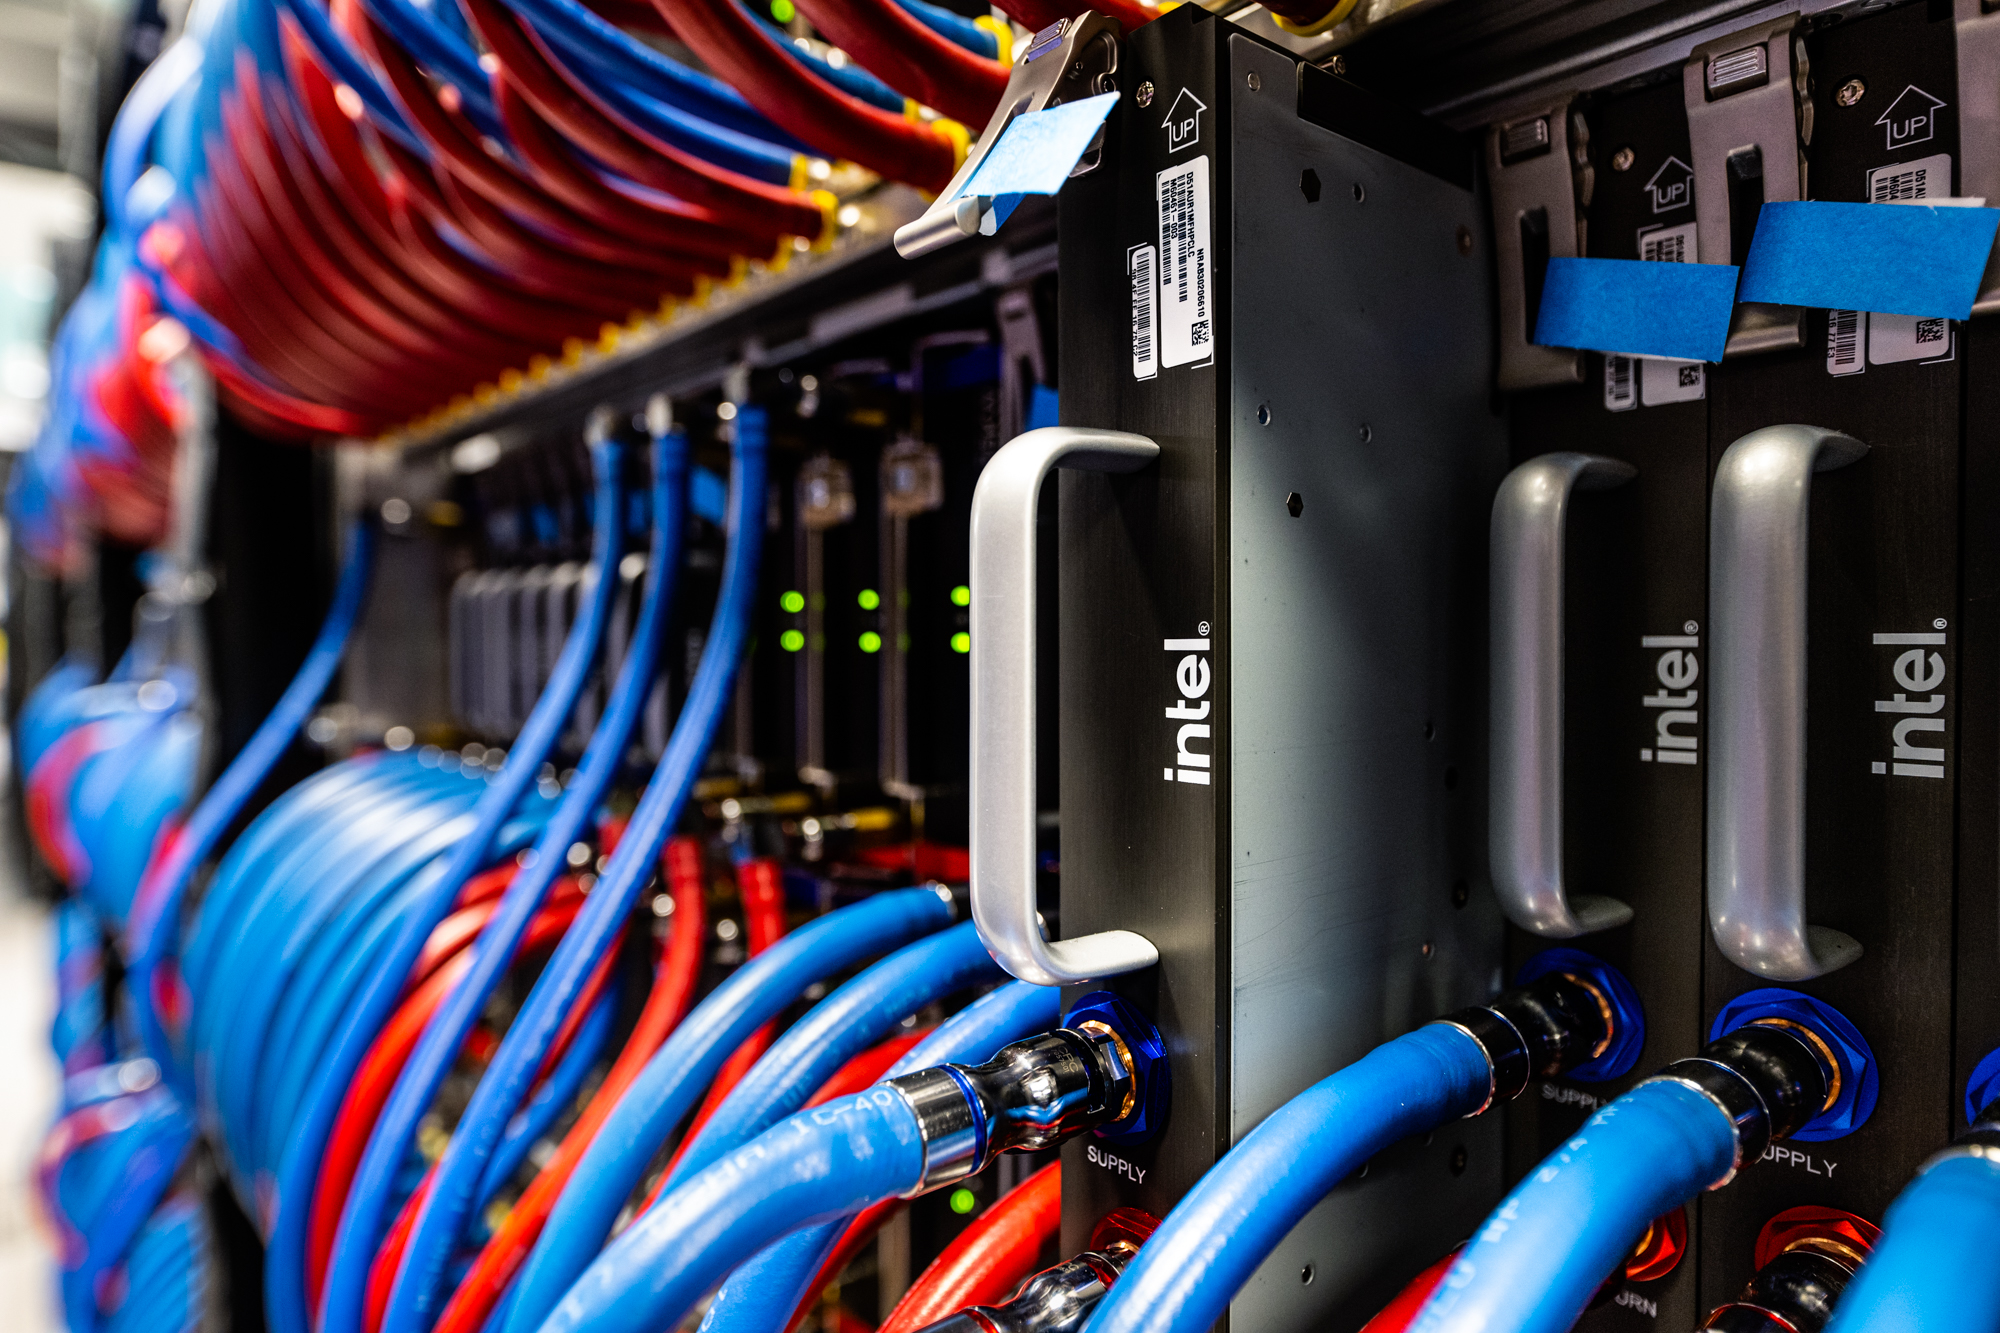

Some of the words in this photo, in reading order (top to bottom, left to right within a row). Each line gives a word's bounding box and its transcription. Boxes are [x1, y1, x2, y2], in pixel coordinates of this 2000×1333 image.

[1173, 118, 1195, 142] UP
[1893, 116, 1928, 139] UP
[1658, 182, 1685, 204] UP
[1889, 175, 1900, 200] M604
[1915, 169, 1927, 199] D51AU
[1186, 171, 1196, 258] D51AUR1MFHPCLC
[1196, 248, 1206, 318] NRAB30206610
[1058, 1046, 1079, 1073] CPC
[1087, 1145, 1146, 1185] SUPPLY
[1763, 1145, 1838, 1178] UPPLY
[1614, 1289, 1658, 1319] URN
